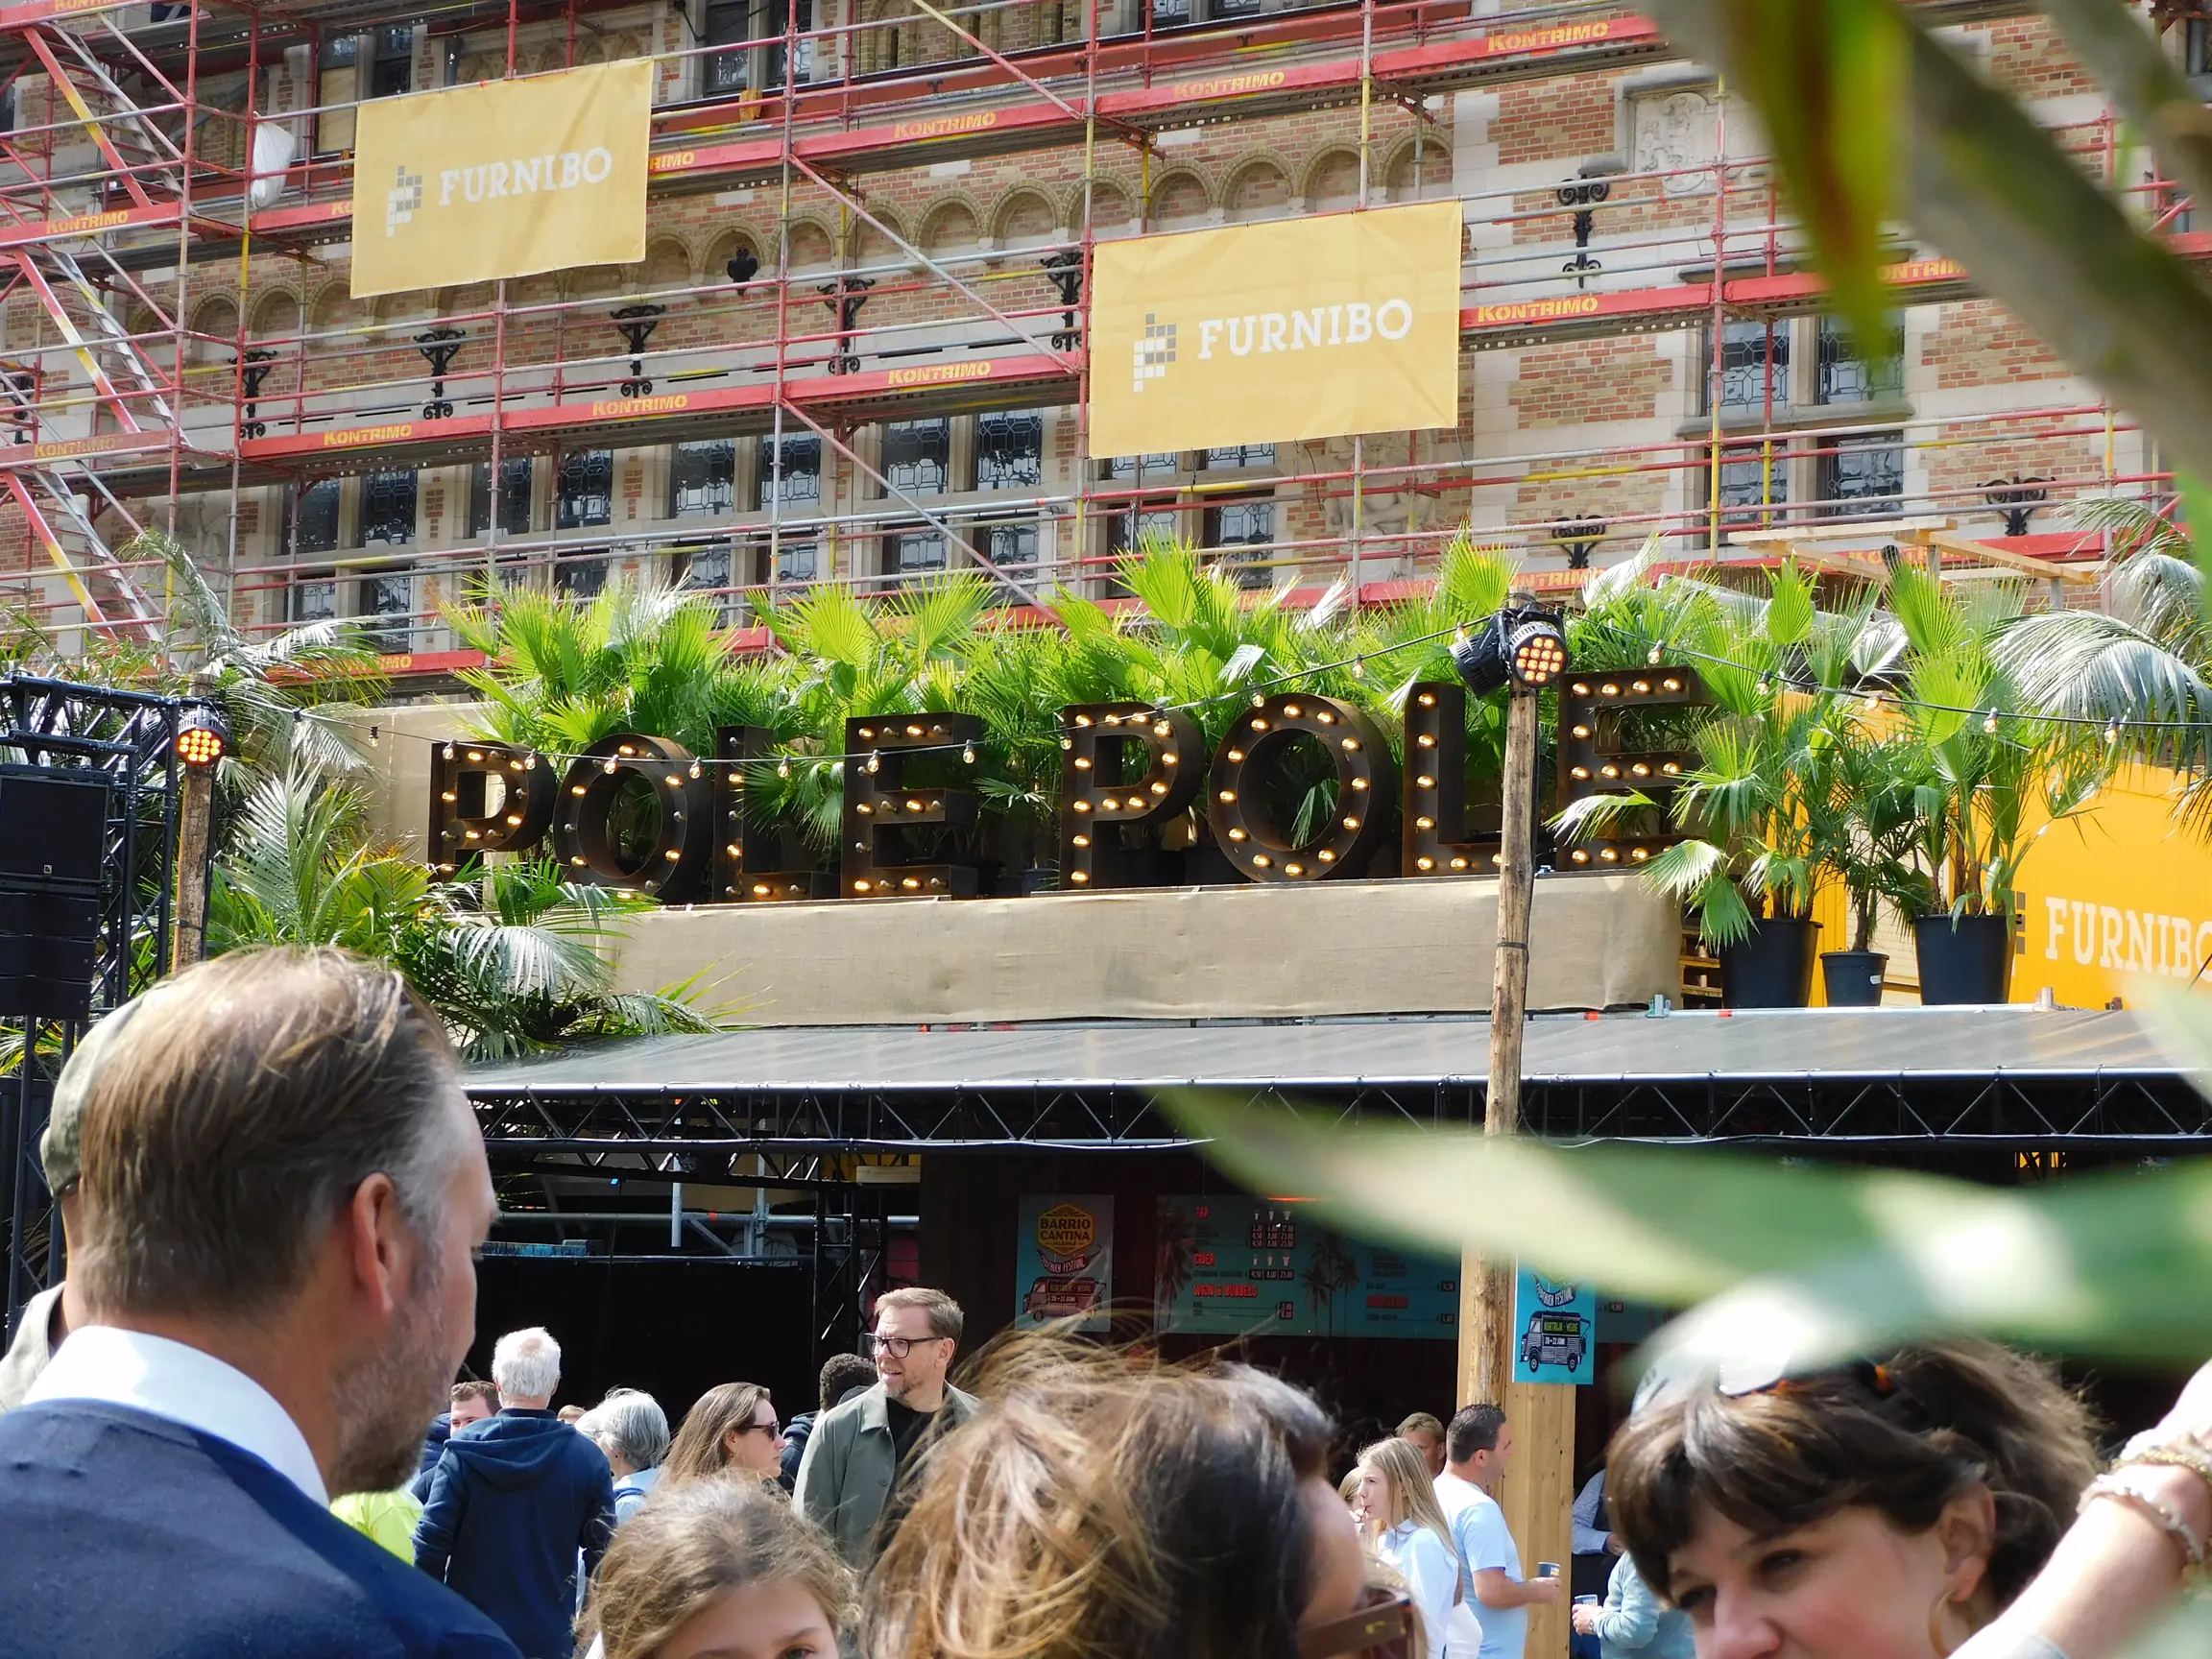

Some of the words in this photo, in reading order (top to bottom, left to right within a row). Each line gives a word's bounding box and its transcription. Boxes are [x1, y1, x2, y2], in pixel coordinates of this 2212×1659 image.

[1487, 22, 1609, 52] KONTRIMO
[1173, 71, 1285, 99] KONTRIMO
[894, 112, 996, 138] KONTRIMO
[439, 146, 613, 205] FURNIBO
[46, 210, 129, 234] KONTRIMO
[1479, 297, 1599, 323] KONTRIMO
[1196, 299, 1413, 359] FURNIBO
[888, 361, 991, 384] KONTRIMO
[592, 395, 688, 417] KONTRIMO
[35, 437, 115, 458] KONTRIMO
[324, 424, 413, 446] KONTRIMO
[428, 711, 977, 904] POLE
[1060, 667, 1709, 891] POLE
[1040, 1218, 1091, 1230] BARRIO
[1040, 1230, 1090, 1241] CANTINA
